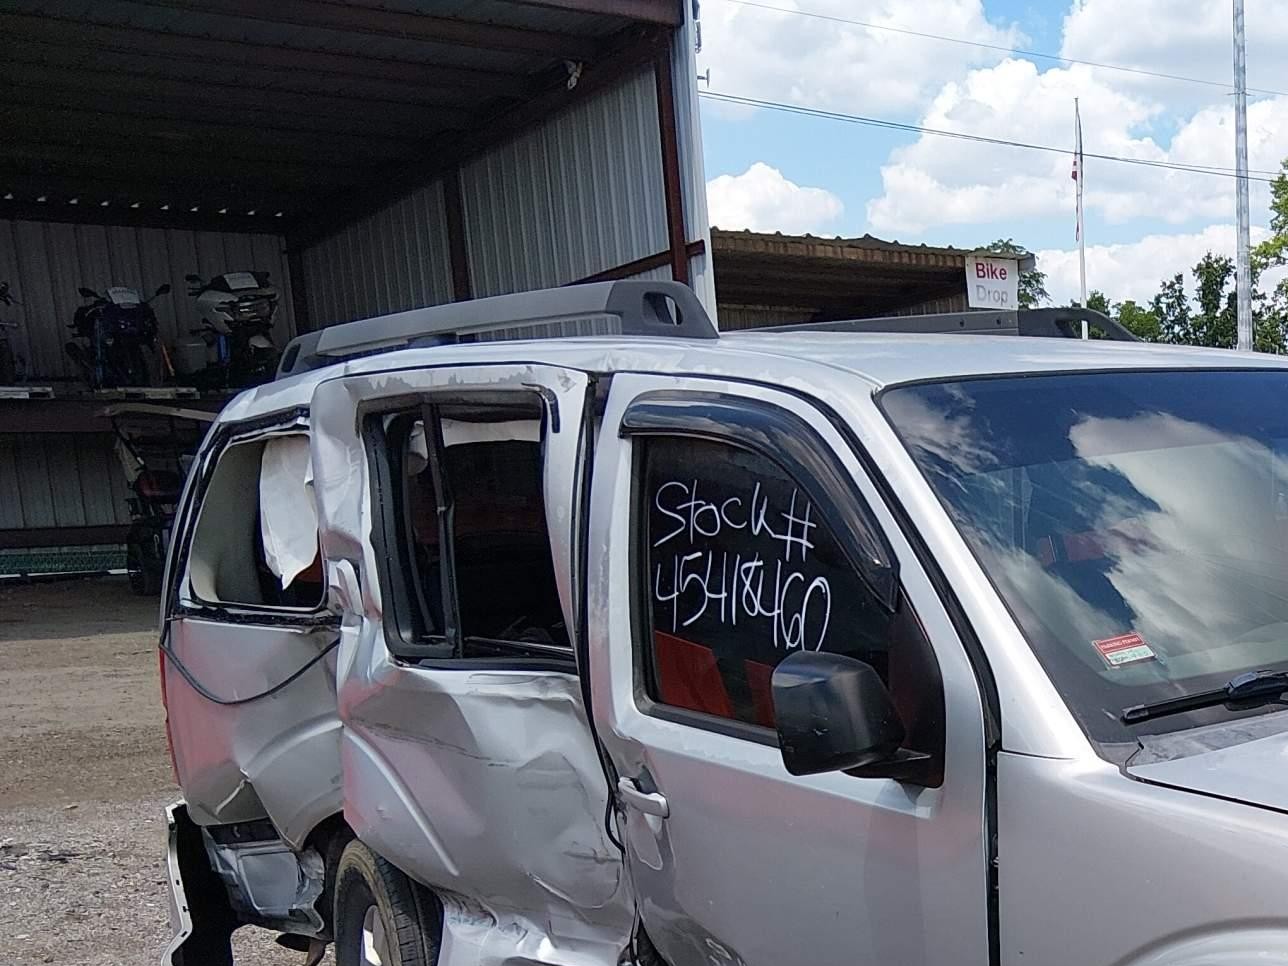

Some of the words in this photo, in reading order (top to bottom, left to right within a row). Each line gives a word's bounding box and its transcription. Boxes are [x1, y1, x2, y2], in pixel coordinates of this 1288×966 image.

[975, 262, 1008, 280] Bike
[975, 284, 1009, 306] Drop
[655, 549, 832, 652] 45418460
